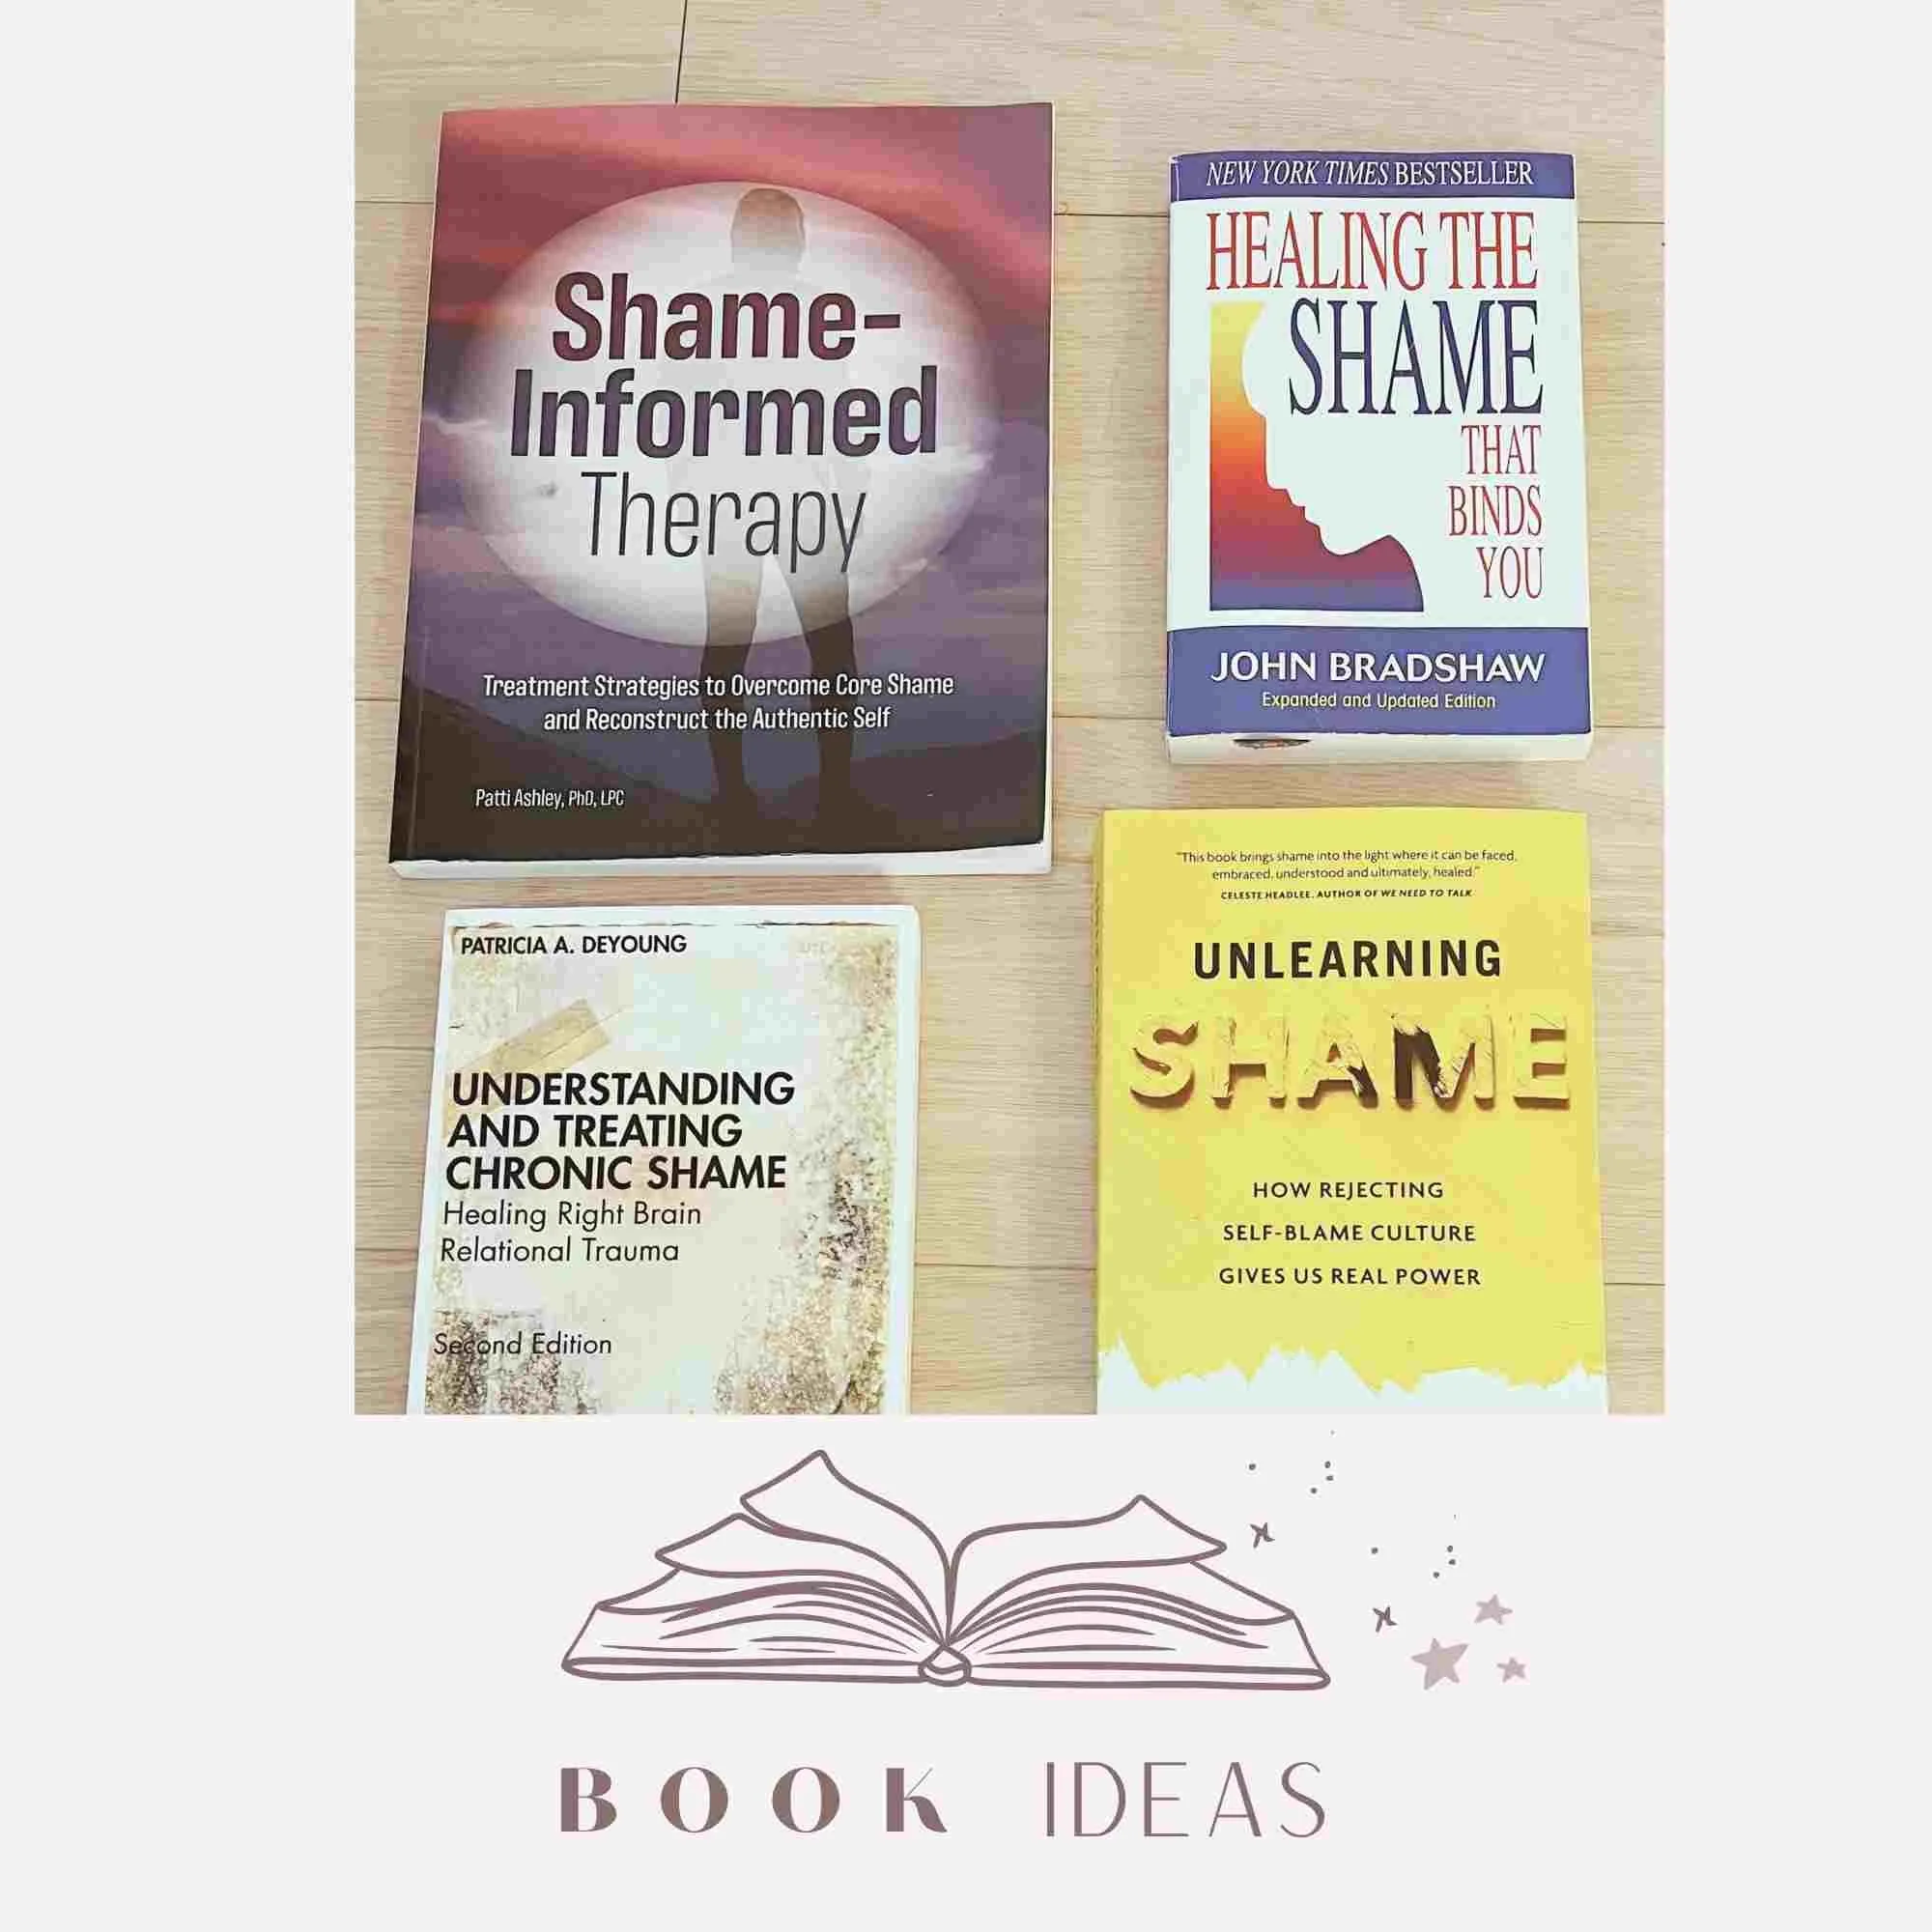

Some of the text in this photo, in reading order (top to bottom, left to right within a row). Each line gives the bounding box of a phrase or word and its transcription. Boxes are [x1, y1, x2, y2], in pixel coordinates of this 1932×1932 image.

[1207, 161, 1535, 186] NEW YORK TIMES BESTSELLER
[1206, 211, 1538, 291] HEALING THE
[552, 271, 901, 362] Shame-
[1289, 298, 1544, 415] SHAME
[510, 364, 938, 459] Informed
[1461, 424, 1542, 475] THAT
[581, 470, 867, 574] Therapy
[1449, 485, 1542, 536] BINDS
[1476, 547, 1545, 599] YOU
[1210, 652, 1546, 682] JOHN BRADSHAW
[483, 673, 954, 700] Treatment Strategies to Overcome Core Shame
[1263, 692, 1496, 711] Expanded and Updated Edition
[544, 706, 892, 730] and Reconstruct the Authentic Self
[475, 788, 624, 810] Patti Ashley, PhD, LPC
[1207, 852, 1236, 863] book
[1240, 852, 1274, 865] brings
[1276, 850, 1315, 862] shame
[1317, 851, 1340, 861] into
[1343, 850, 1362, 860] the
[1365, 850, 1389, 863] light
[1391, 850, 1429, 860] where
[1431, 850, 1438, 860] it
[1464, 850, 1478, 860] be
[1276, 867, 1344, 879] understood
[1347, 867, 1368, 877] and
[1221, 891, 1264, 899] CELESTE
[1317, 889, 1362, 899] AUTHOR
[461, 934, 687, 954] PATRICIA A. DEYOUNG
[1193, 939, 1501, 980] UNLEARNING
[1128, 1009, 1572, 1111] SHAME
[451, 1071, 795, 1107] UNDERSTANDING
[446, 1114, 743, 1149] AND TREATING
[446, 1155, 787, 1190] CHRONIC SHAME
[1253, 1180, 1444, 1200] HOW REJECTING
[443, 1200, 701, 1232] Healing Right Brain
[1223, 1224, 1477, 1242] SELF-BLAME CULTURE
[440, 1237, 680, 1264] Relational Trauma
[1220, 1267, 1481, 1286] GIVES US REAL POWER
[434, 1330, 611, 1354] Second Edition
